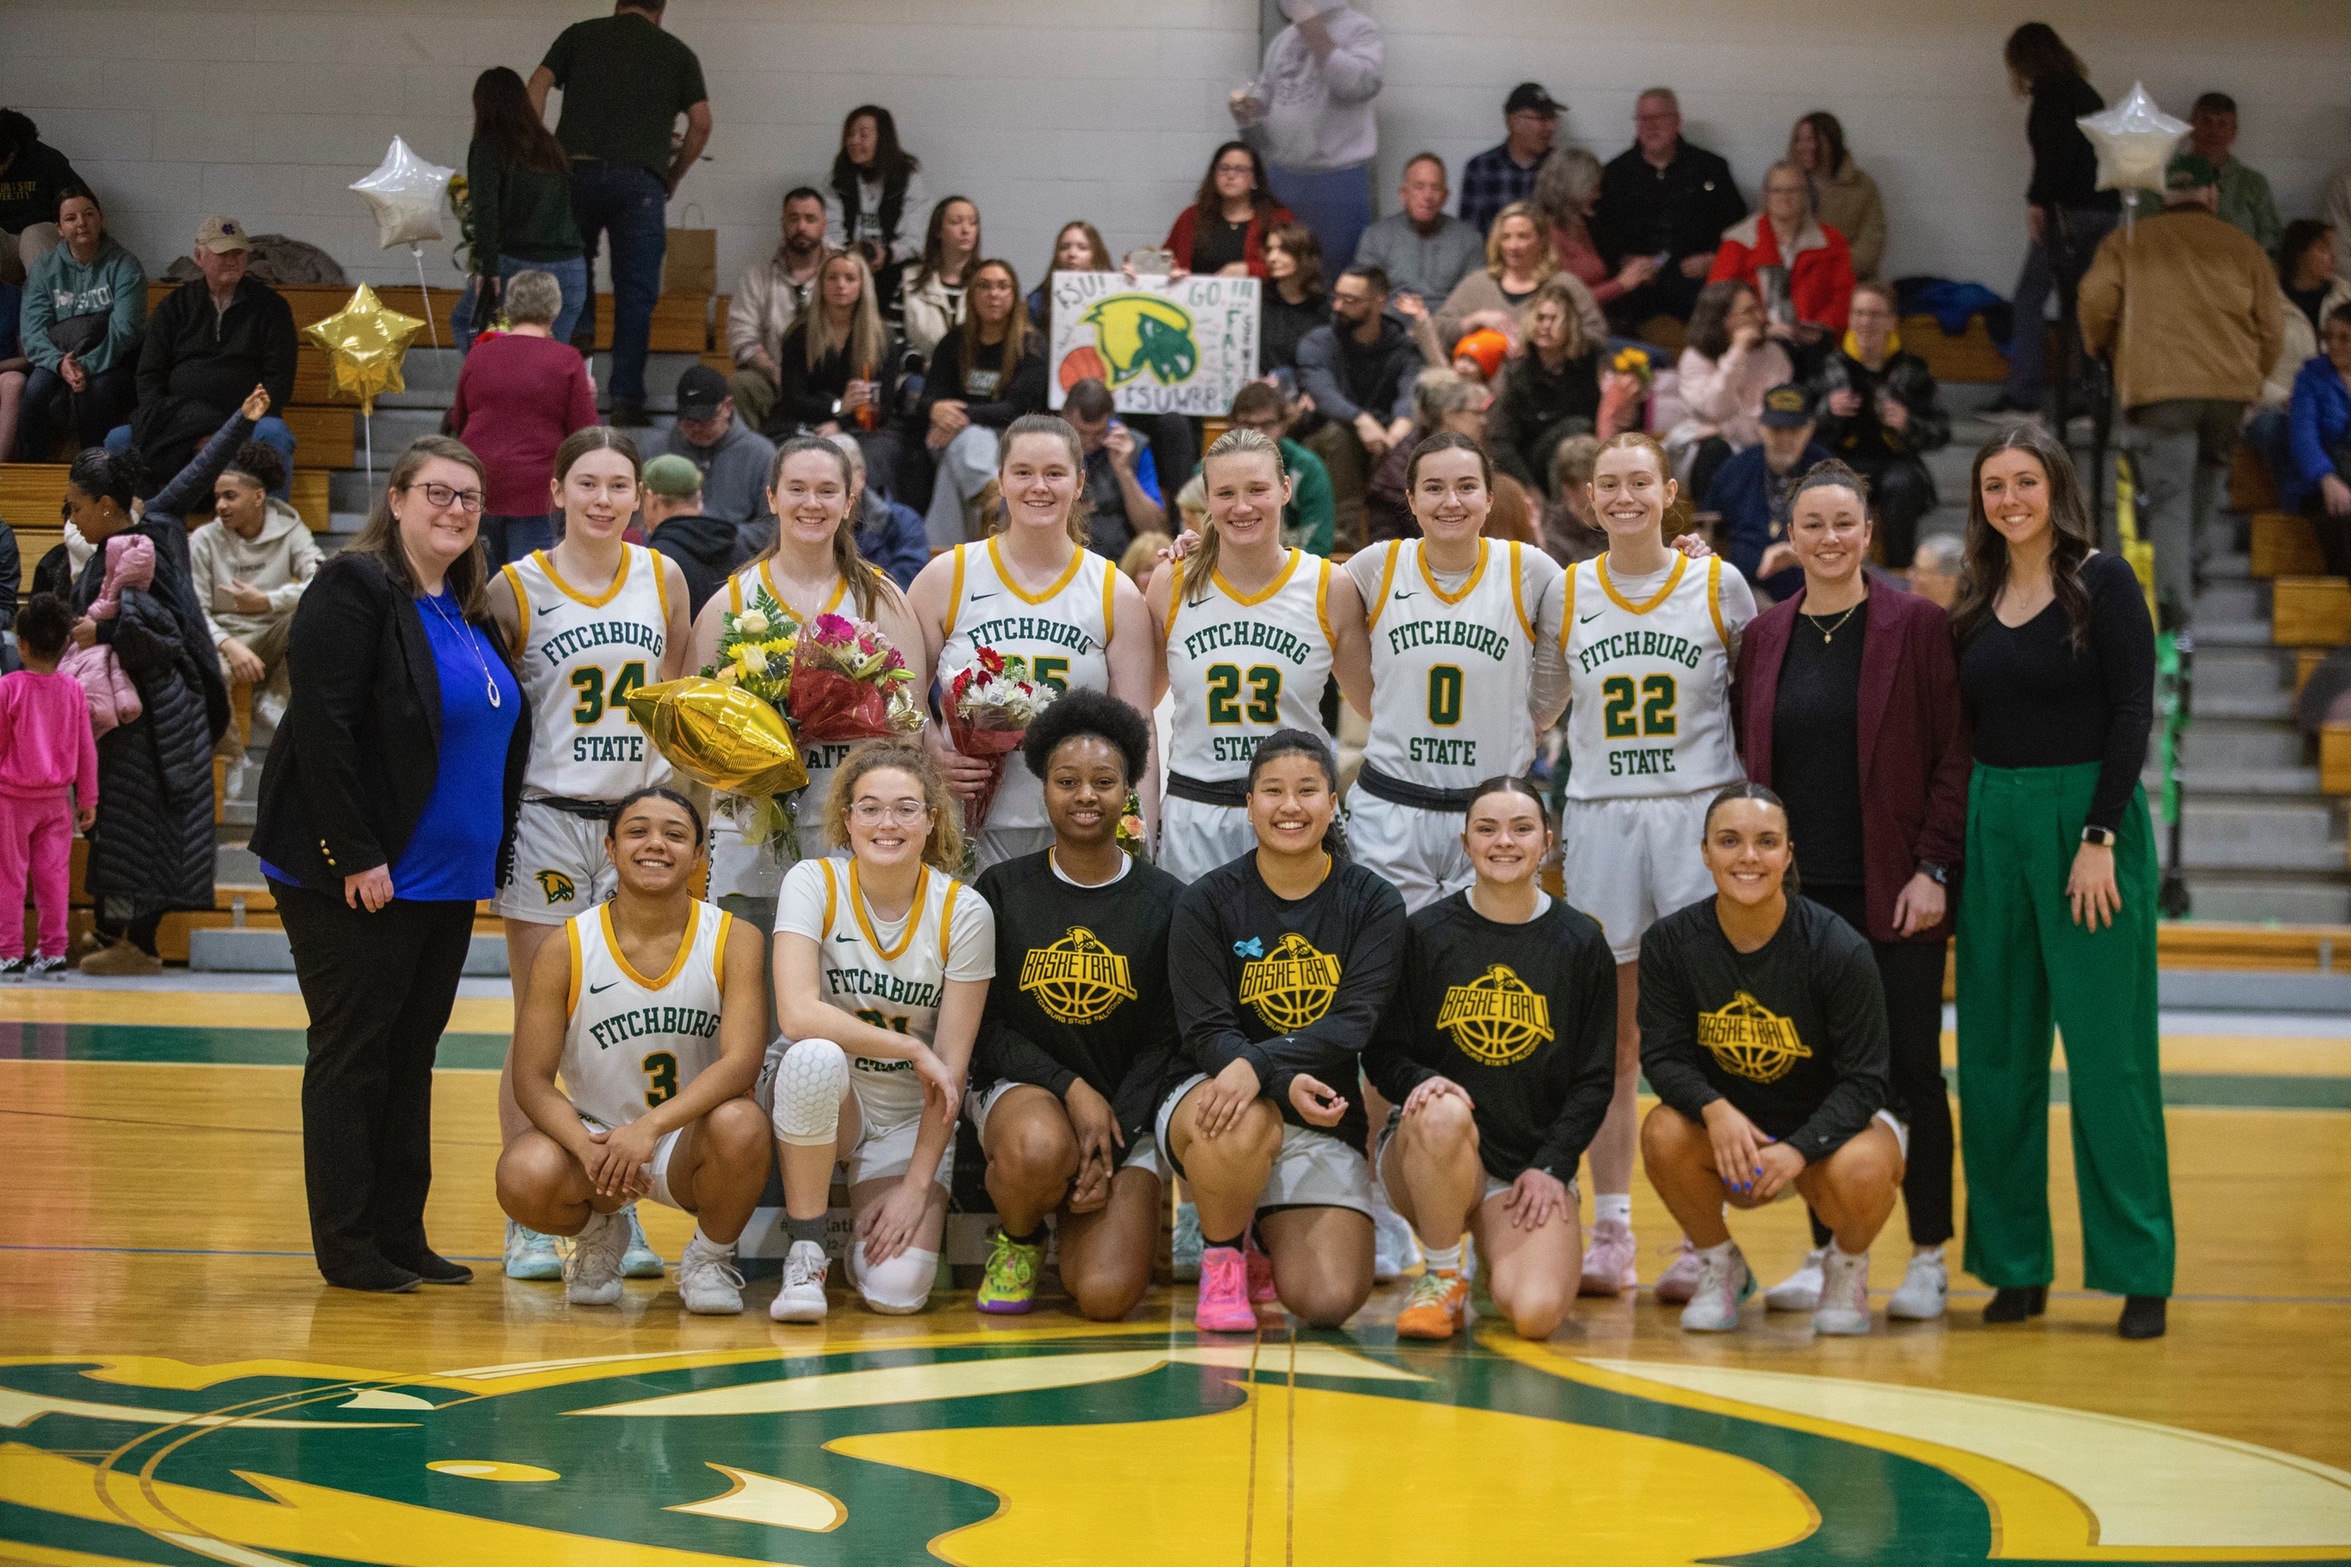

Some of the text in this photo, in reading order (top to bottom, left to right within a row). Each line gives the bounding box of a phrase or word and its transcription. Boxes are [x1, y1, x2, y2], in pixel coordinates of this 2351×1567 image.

[1189, 282, 1221, 307] GO
[541, 622, 663, 667] FITCHBURG
[967, 617, 1093, 655] FITCHBURG
[1185, 621, 1310, 665] FITCHBURG
[1388, 620, 1509, 662] FITCHBURG
[1579, 631, 1702, 674] FITCHBURG
[570, 660, 647, 726] 34
[997, 654, 1070, 695] 5
[1206, 662, 1283, 726] 23
[1427, 663, 1464, 728] 0
[1601, 673, 1677, 740] 22
[574, 736, 643, 762] STATE
[1410, 737, 1476, 767] STATE
[1609, 748, 1676, 776] STATE
[1020, 950, 1137, 997] BASKETBALL
[589, 1006, 721, 1050] FITCHBURG
[1438, 987, 1554, 1036] BASKETBALL
[1699, 1015, 1811, 1054] BASKETBALL
[641, 1050, 679, 1110] 3
